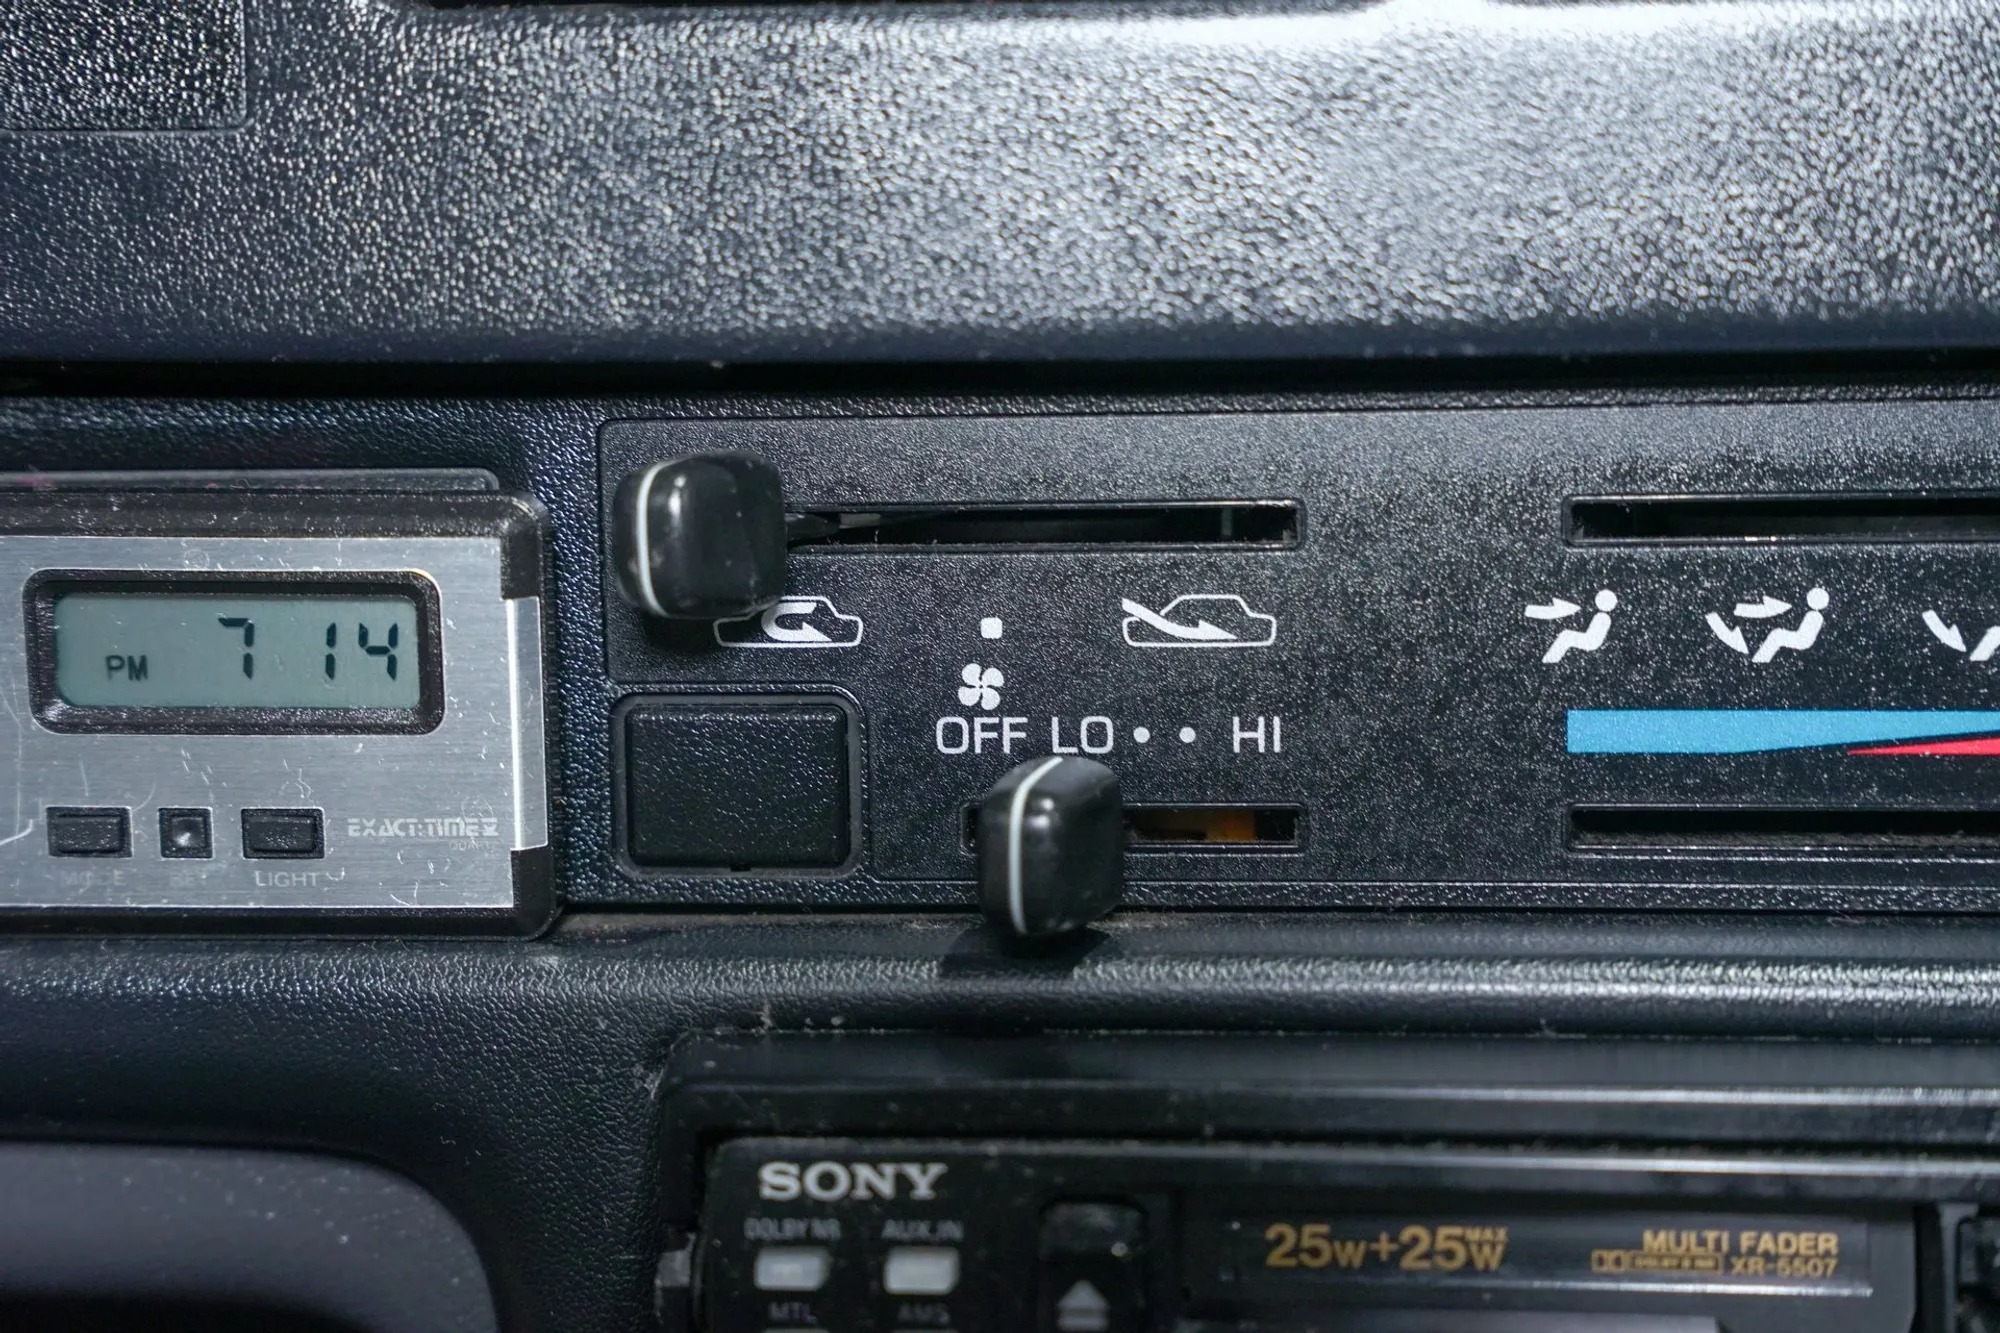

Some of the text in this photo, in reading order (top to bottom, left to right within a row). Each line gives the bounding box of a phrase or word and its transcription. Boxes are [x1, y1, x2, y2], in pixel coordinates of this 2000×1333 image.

[104, 654, 149, 682] PM
[935, 716, 1282, 754] OFF LO HI
[255, 870, 317, 887] LIGHT
[758, 1161, 949, 1201] SONY
[1642, 1229, 1840, 1255] MULTI FADER
